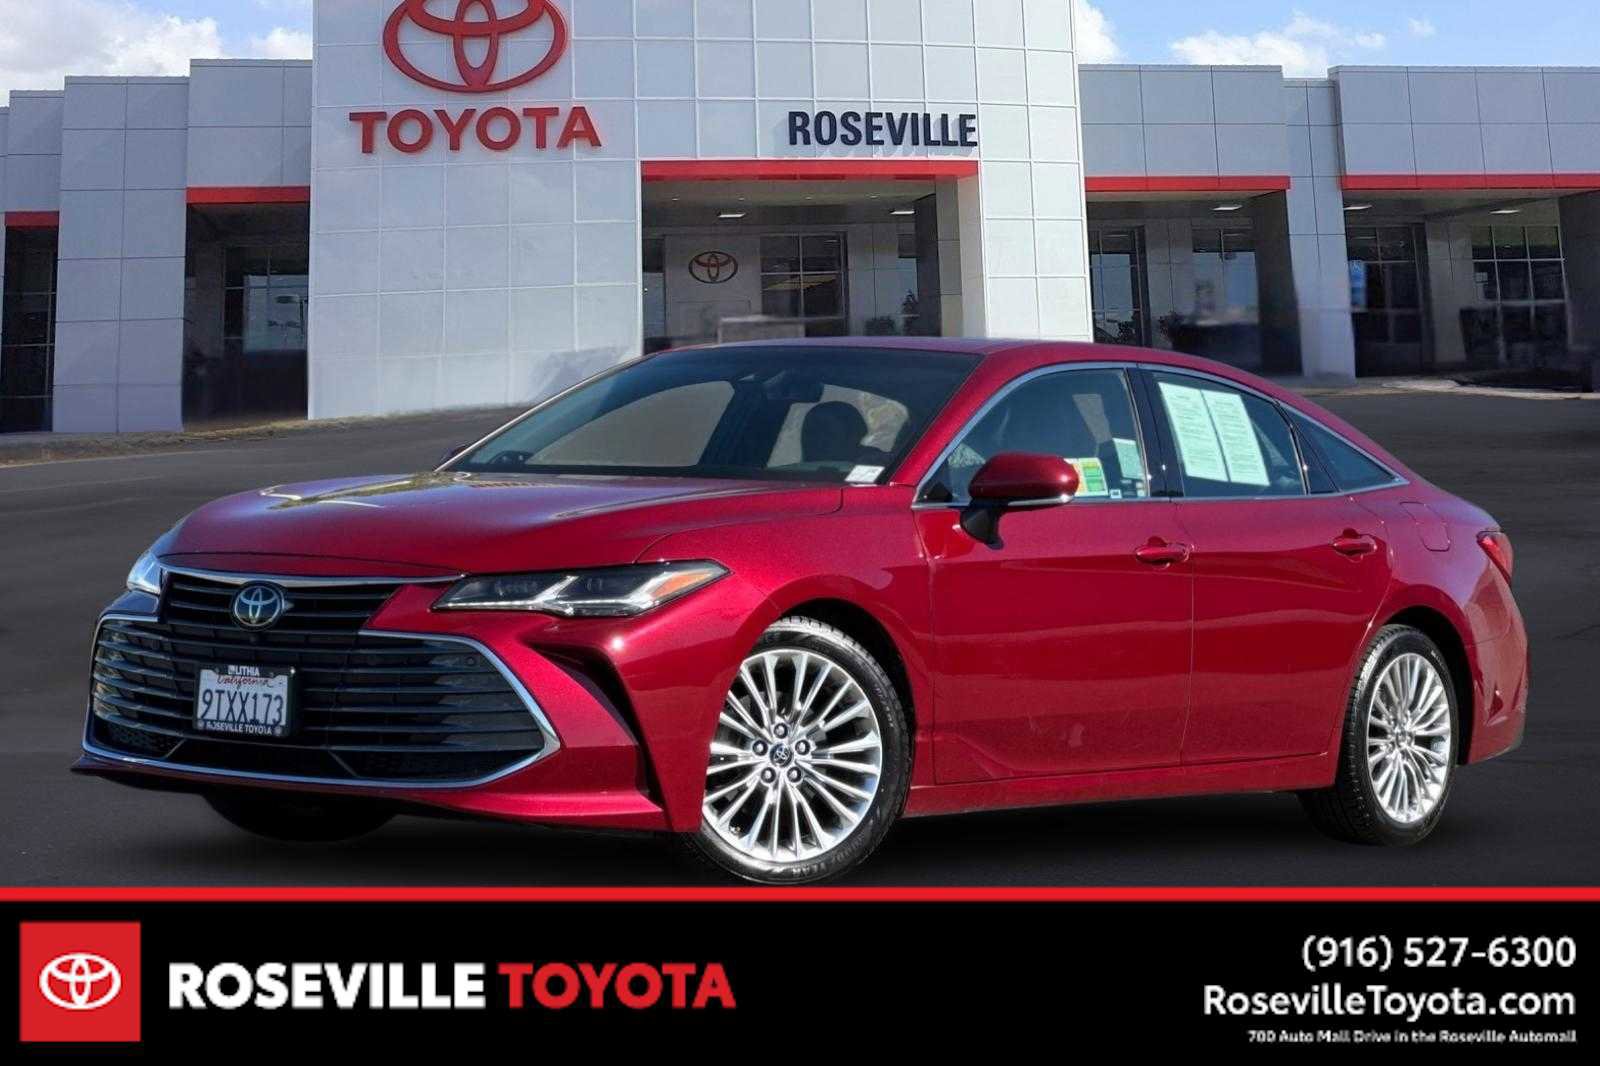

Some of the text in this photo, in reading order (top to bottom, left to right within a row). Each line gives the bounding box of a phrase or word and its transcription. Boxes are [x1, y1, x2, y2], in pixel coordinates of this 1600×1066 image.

[350, 105, 602, 154] TOYOTA
[788, 110, 979, 147] ROSEVILLE
[235, 665, 261, 677] LITHIA
[200, 688, 285, 729] 9TXX173
[206, 720, 273, 736] ROSEVILLE TOYOTA
